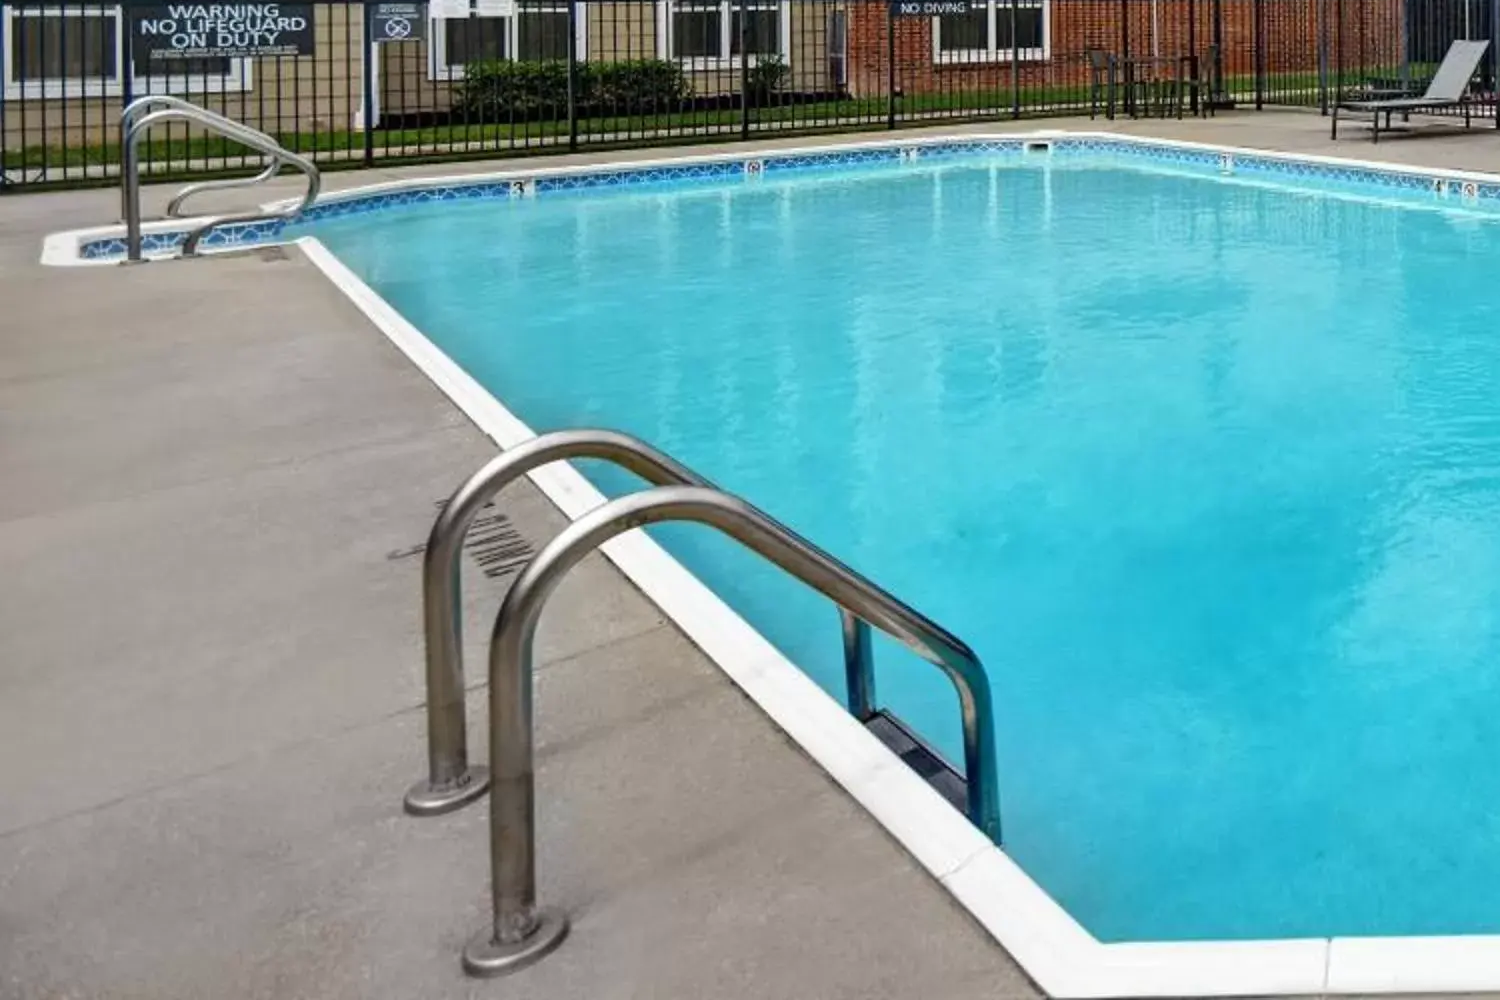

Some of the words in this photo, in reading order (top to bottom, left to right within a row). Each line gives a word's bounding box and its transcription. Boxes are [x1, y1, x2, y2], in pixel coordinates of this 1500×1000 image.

[168, 3, 279, 20] WARNING
[901, 2, 920, 14] NO
[924, 2, 965, 14] DIVING
[141, 19, 177, 34] NO
[187, 17, 306, 34] LIFEGUARD
[171, 32, 206, 48] ON
[217, 31, 279, 47] DUTY
